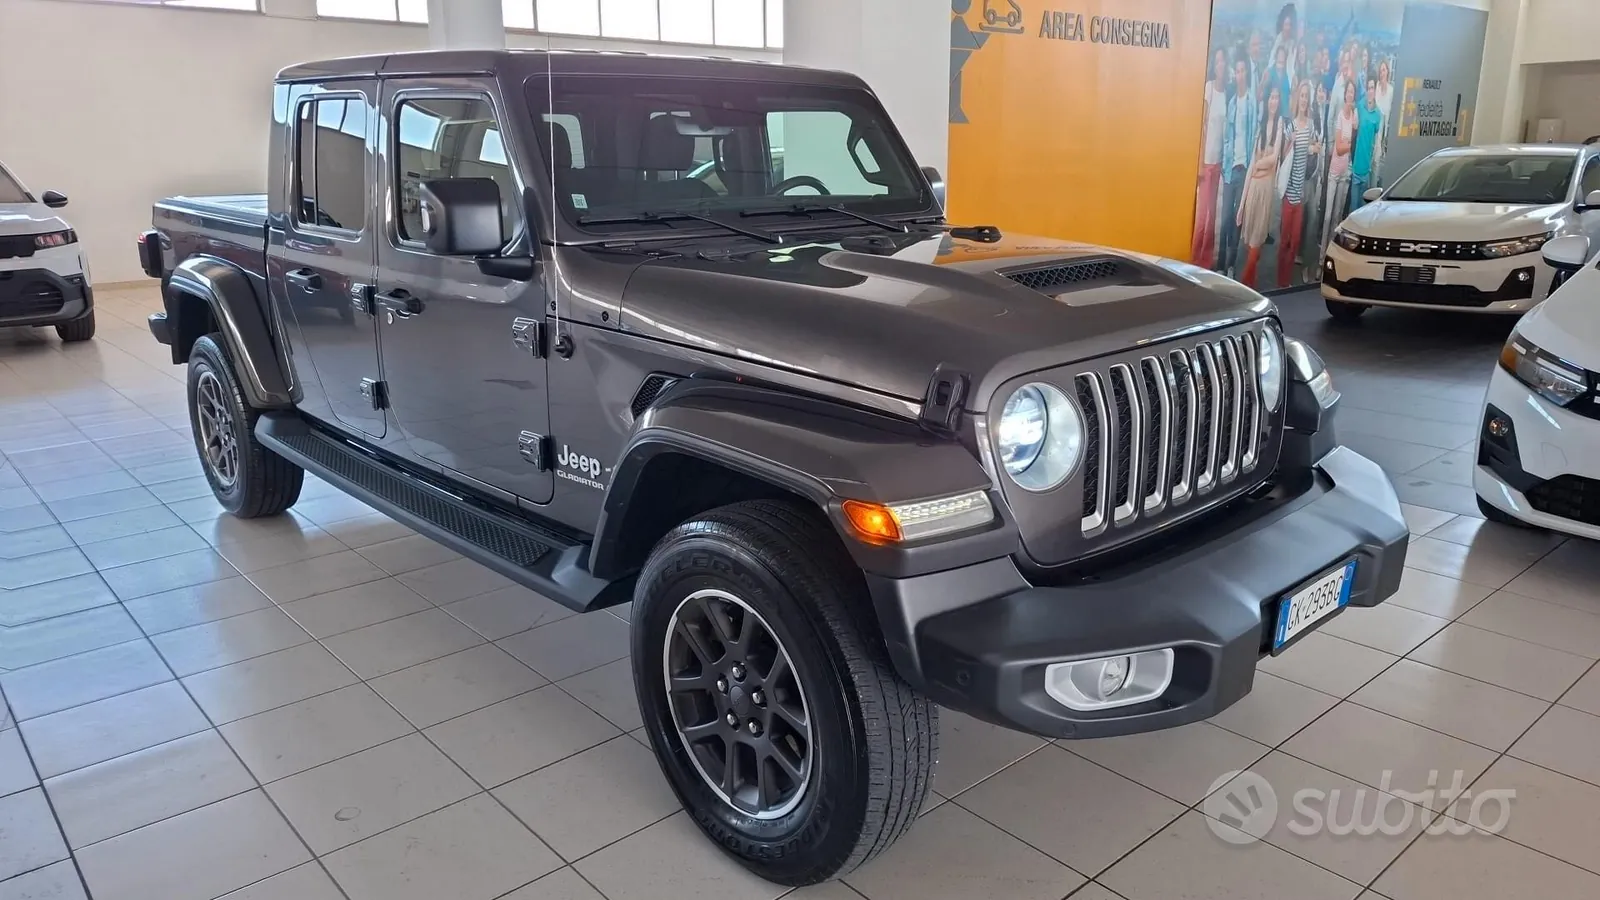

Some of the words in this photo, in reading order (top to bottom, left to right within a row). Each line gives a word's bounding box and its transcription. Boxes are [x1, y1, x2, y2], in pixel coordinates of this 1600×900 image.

[1038, 10, 1085, 41] AREA
[1090, 15, 1170, 48] CONSEGNA
[1423, 79, 1442, 90] RENAULT
[557, 444, 601, 479] Jeep
[556, 469, 605, 491] GLADIATOR
